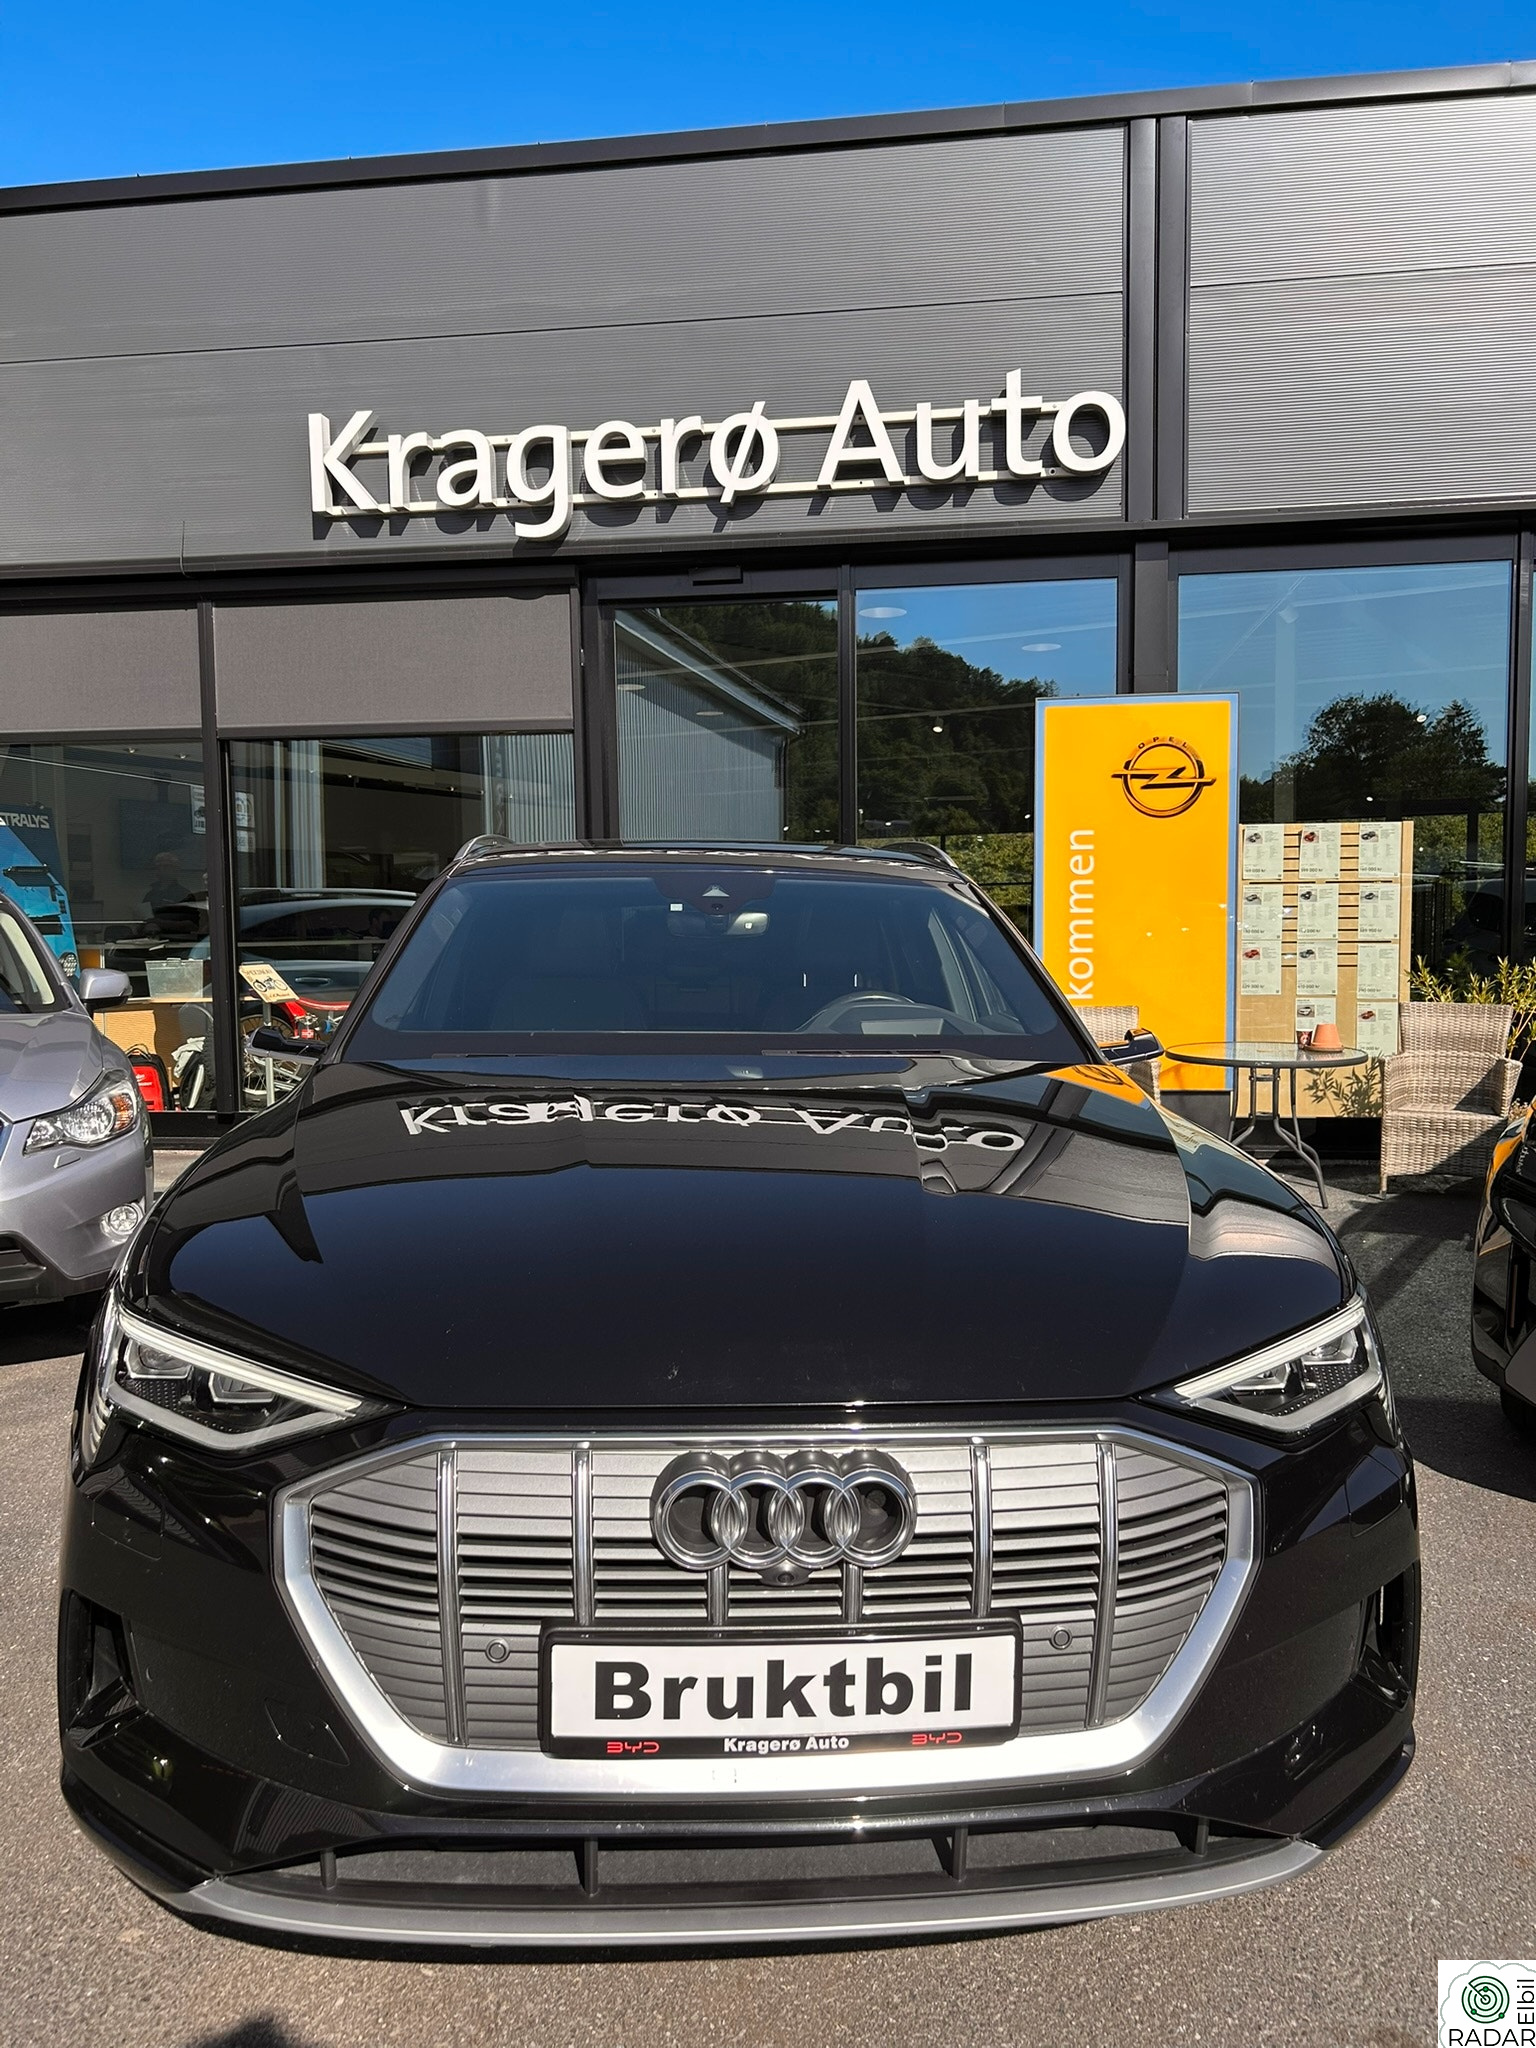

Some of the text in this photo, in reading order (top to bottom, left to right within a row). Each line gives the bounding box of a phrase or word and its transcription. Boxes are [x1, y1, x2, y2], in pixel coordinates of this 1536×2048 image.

[308, 367, 1126, 540] Kragerø Auto
[1138, 736, 1187, 750] OPEL
[594, 1653, 973, 1720] Bruktbil
[724, 1736, 850, 1754] Kragerø Auto
[912, 1732, 962, 1745] BYD
[607, 1741, 660, 1753] BYD
